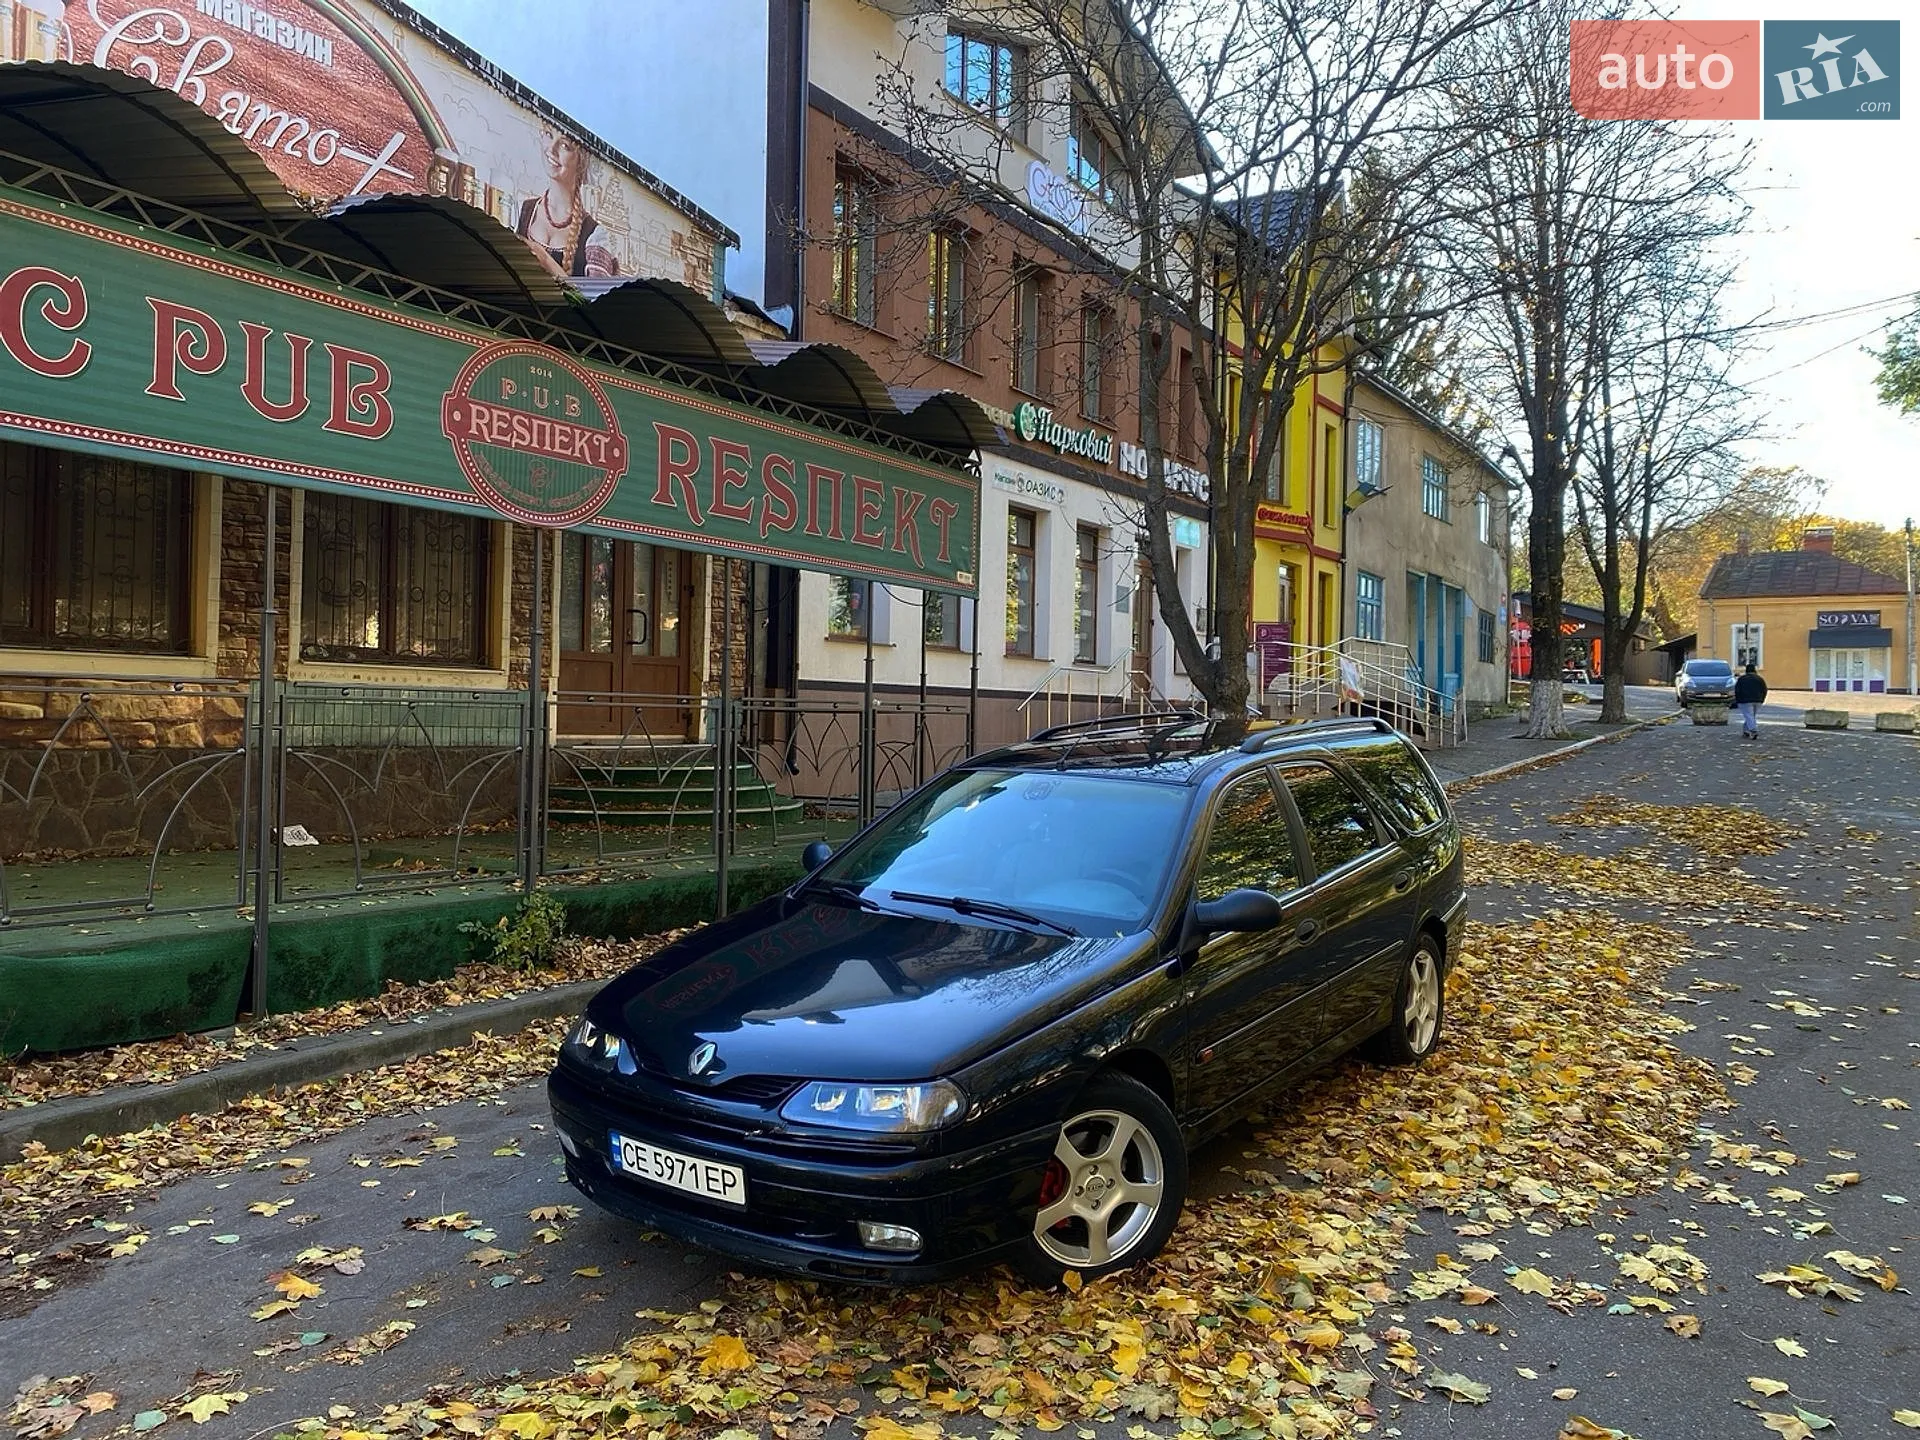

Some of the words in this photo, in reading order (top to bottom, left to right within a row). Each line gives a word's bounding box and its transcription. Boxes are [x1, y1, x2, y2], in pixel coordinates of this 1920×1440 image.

[144, 296, 394, 440] PUB
[530, 365, 553, 379] 2014
[1037, 406, 1114, 465] Парковий
[1025, 479, 1056, 500] ОАЗИС
[622, 1142, 649, 1174] CE
[653, 1151, 700, 1190] 5971
[704, 1165, 737, 1196] EP
